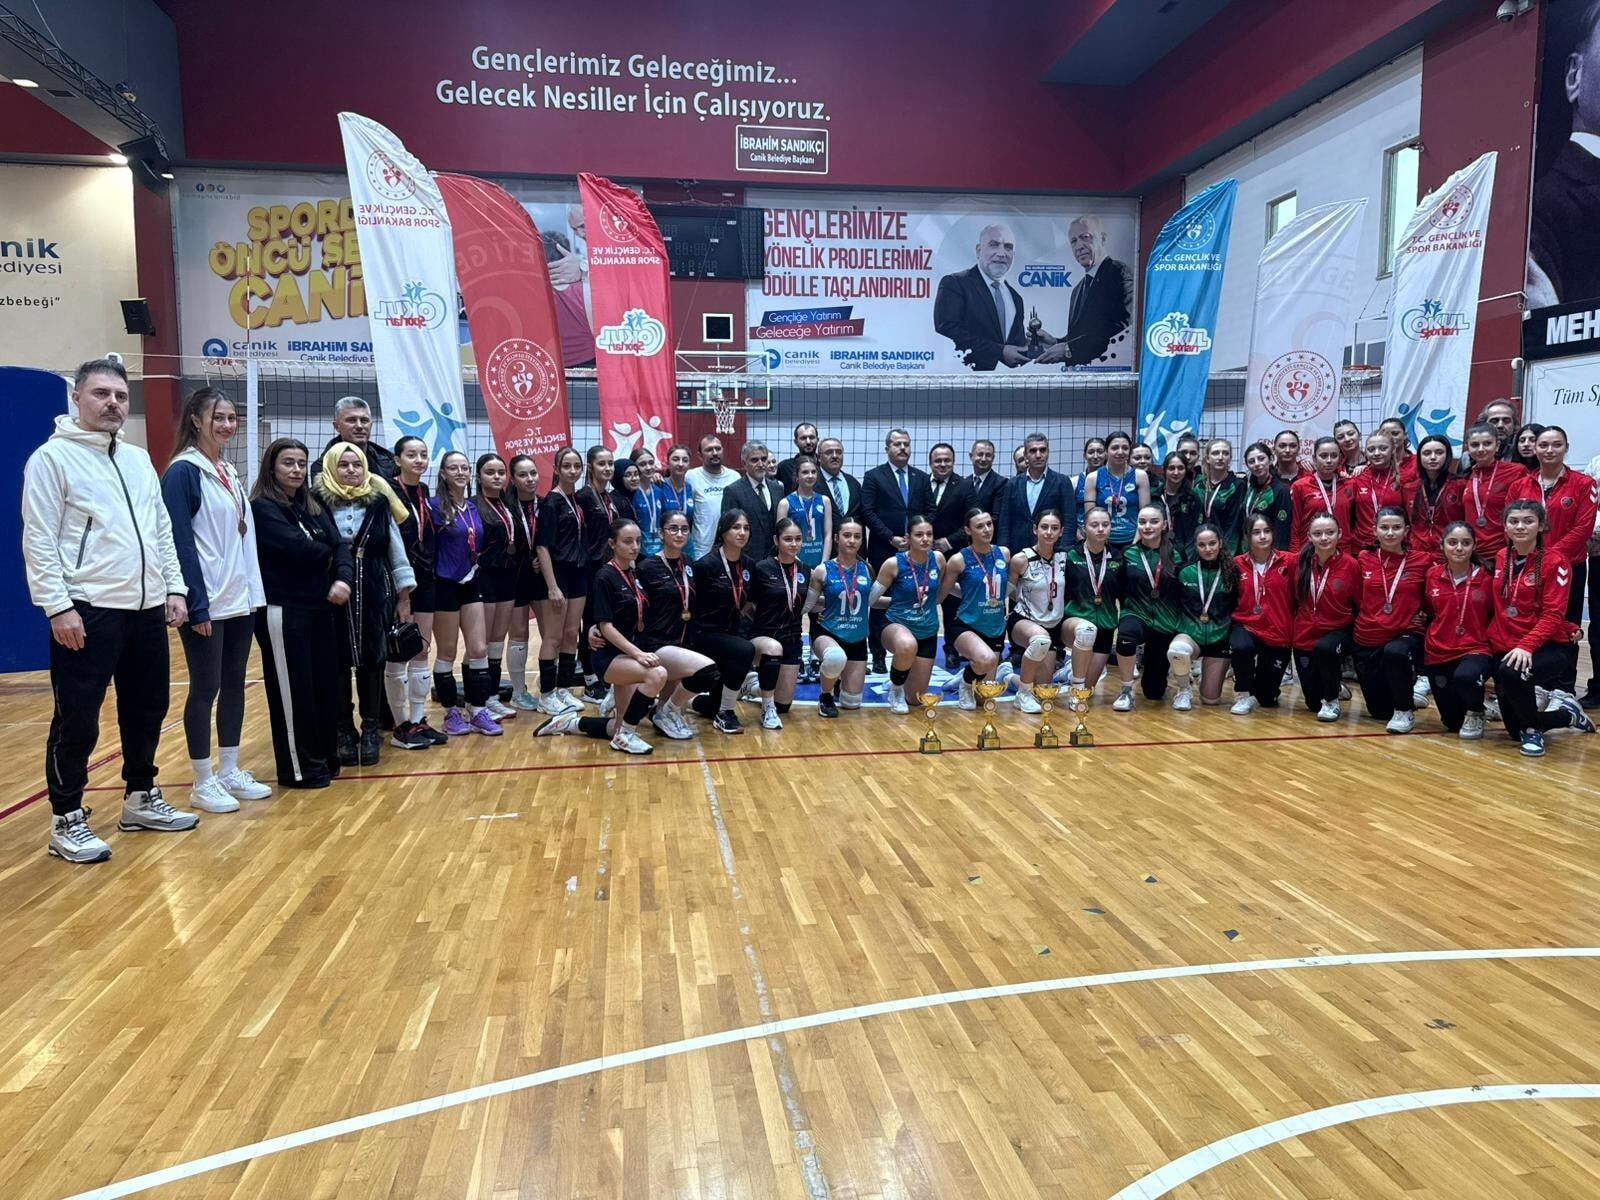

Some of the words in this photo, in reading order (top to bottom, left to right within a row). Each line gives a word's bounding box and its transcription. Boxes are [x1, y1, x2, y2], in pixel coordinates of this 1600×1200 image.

[472, 46, 620, 78] Gençlerimiz
[628, 54, 797, 88] Geleceğimiz...
[436, 79, 536, 108] Gelecek
[544, 84, 636, 113] Nesiller
[644, 84, 687, 118] İçin
[694, 91, 830, 123] Çalışıyoruz.
[740, 134, 778, 150] İBRAHİM
[781, 139, 824, 155] SANDIKÇI
[750, 152, 766, 161] Canik
[768, 154, 791, 164] Belediye
[792, 155, 814, 165] Başkanı
[764, 206, 908, 244] GENÇLERİMİZE
[1407, 244, 1430, 254] SPOR
[1433, 239, 1482, 251] BAKANLIĞI
[209, 235, 312, 280] ÖNCÜ
[762, 242, 825, 269] YÖNELİK
[829, 246, 933, 270] PROJELERİMİZ
[1174, 254, 1209, 264] GENÇLİK
[0, 261, 62, 275] diyesi
[762, 272, 818, 297] ÖDÜLLE
[822, 276, 930, 301] TAÇLANDIRILDI
[769, 312, 808, 324] Gençliğe
[810, 312, 842, 320] Yatırım
[756, 325, 811, 339] Geleceğe
[814, 324, 854, 335] Yatırım
[232, 341, 278, 350] canik
[300, 354, 326, 362] Canik
[785, 350, 820, 358] canik
[881, 351, 934, 361] SANDIKÇI
[863, 362, 895, 371] Belediye
[896, 362, 925, 371] Başkanı
[1554, 388, 1584, 405] Tüm
[838, 590, 862, 615] 10
